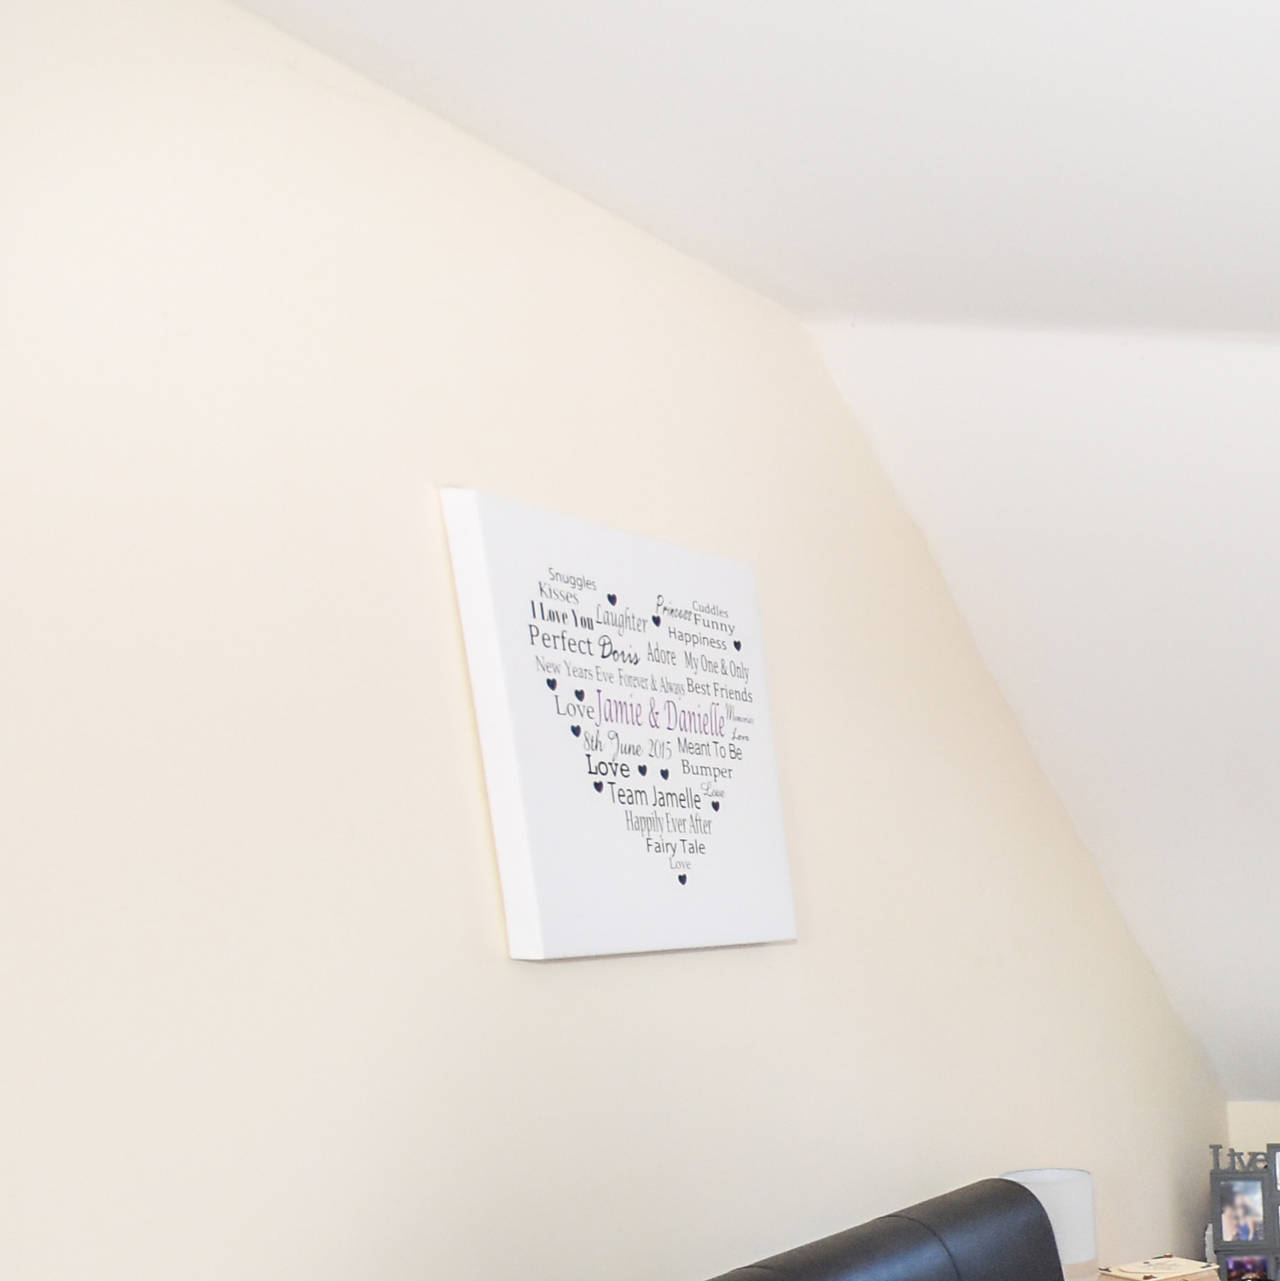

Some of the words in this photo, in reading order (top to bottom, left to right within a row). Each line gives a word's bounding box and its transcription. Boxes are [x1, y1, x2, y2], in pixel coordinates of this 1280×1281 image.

[548, 567, 597, 590] Snuggles
[538, 581, 579, 604] Kisses
[531, 600, 536, 619] I
[540, 602, 568, 624] Love
[571, 609, 594, 630] You
[595, 603, 648, 636] Laughter
[692, 600, 728, 618] Cuddles
[694, 613, 735, 636] Funny
[528, 624, 594, 656] Perfect
[598, 635, 640, 665] Doris
[668, 626, 727, 650] Happiness
[648, 641, 676, 666] Adore
[536, 655, 560, 674] New
[564, 660, 593, 680] Years
[595, 665, 614, 683] Eve
[684, 651, 699, 675] My
[701, 654, 719, 673] One
[720, 658, 728, 676] &
[730, 660, 749, 684] Only
[686, 677, 711, 696] Best
[713, 682, 753, 703] Friends
[554, 695, 594, 719] Love
[595, 689, 642, 727] Jamie
[649, 697, 659, 729] &
[664, 700, 725, 737] Danielle
[584, 729, 603, 751] 8th
[608, 730, 642, 761] June
[648, 739, 672, 760] 2015
[677, 737, 711, 757] Meant
[712, 741, 726, 758] To
[729, 743, 742, 760] Be
[585, 754, 630, 778] Love
[681, 759, 733, 782] Bumper
[607, 781, 648, 805] Team
[652, 786, 701, 809] Jamelle
[625, 810, 664, 841] Happily
[666, 812, 687, 833] Ever
[689, 813, 712, 834] After
[646, 837, 677, 858] Fairy
[680, 839, 706, 854] Tale
[669, 857, 692, 870] Love
